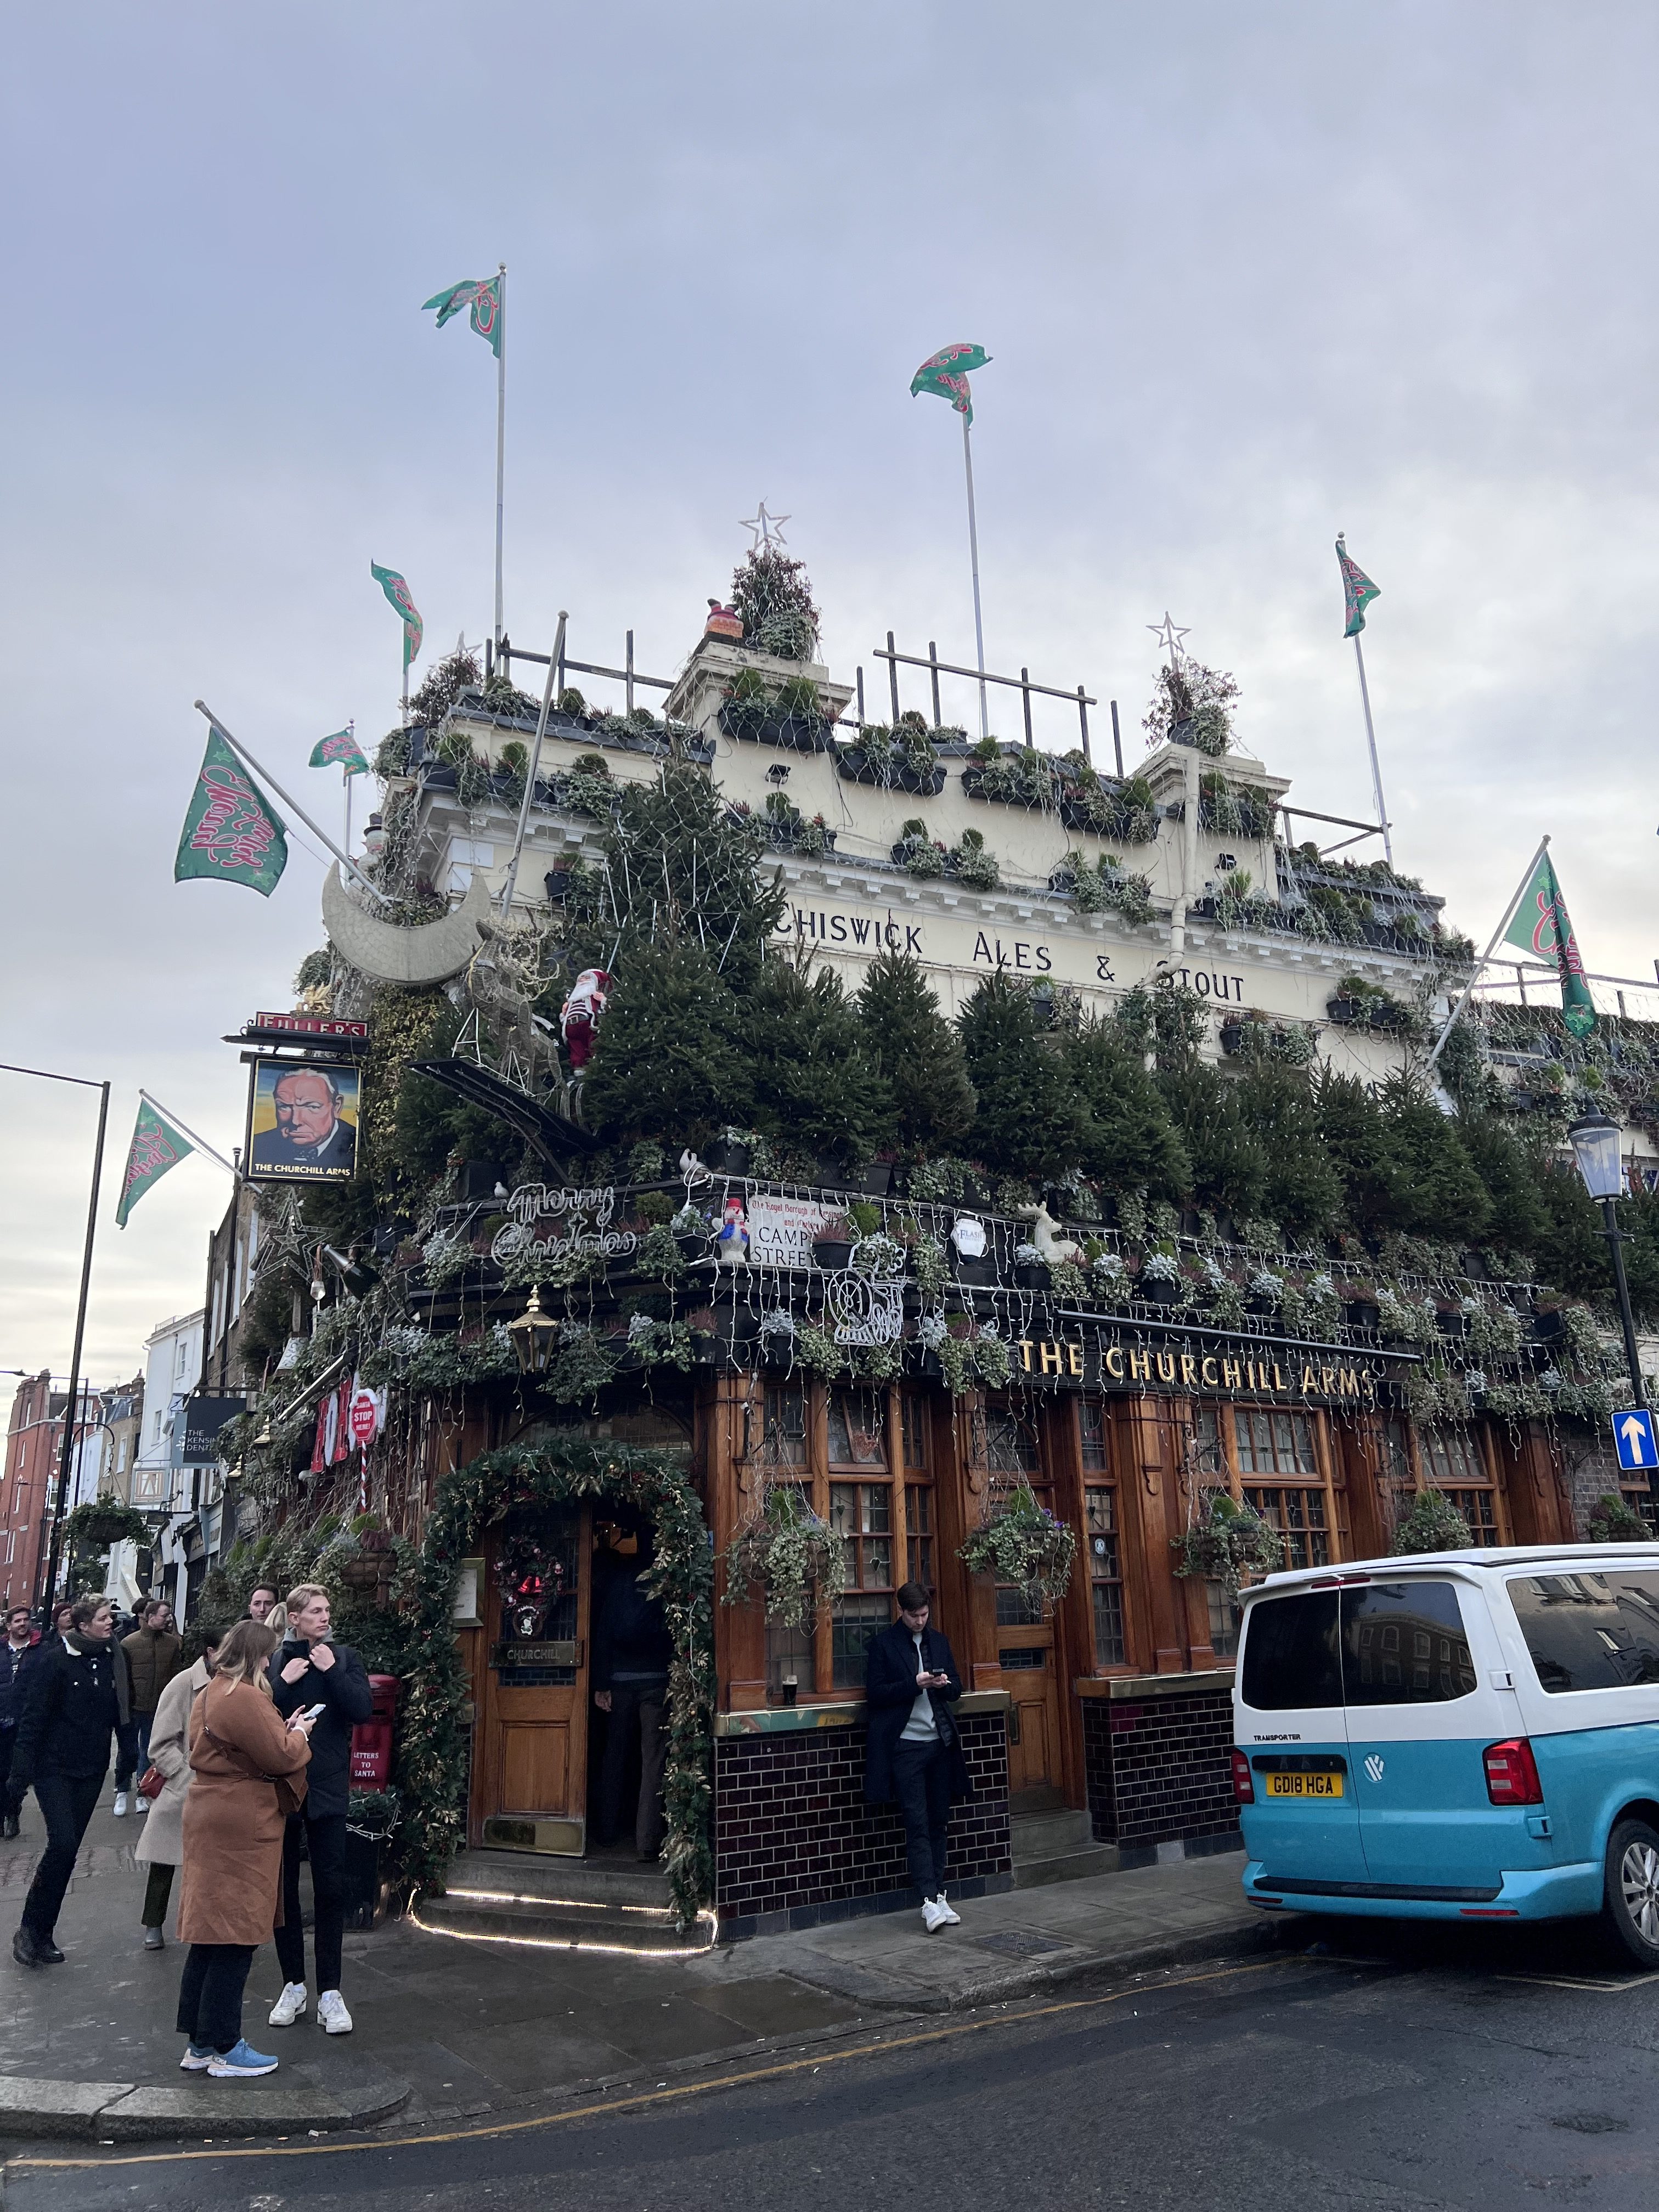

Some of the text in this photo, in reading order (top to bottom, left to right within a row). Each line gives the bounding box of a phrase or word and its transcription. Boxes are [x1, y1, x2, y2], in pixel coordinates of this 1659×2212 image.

[774, 901, 923, 953] CHISWICK
[973, 932, 1052, 971] ALES
[1097, 955, 1115, 982] &
[255, 1164, 351, 1176] THE CHURCHILL ARMS
[507, 1183, 614, 1227] Merry
[766, 1201, 782, 1214] Royal
[785, 1204, 808, 1217] Borough
[491, 1212, 636, 1268] Christmas
[759, 1227, 808, 1246] CAMP
[960, 1229, 982, 1239] FLASH
[754, 1246, 817, 1268] STREET
[1019, 1340, 1374, 1398] THE CHURCHILL ARMS
[354, 1410, 373, 1423] STOP
[507, 1649, 561, 1660] CHURCHILL
[1306, 1776, 1334, 1794] HGA
